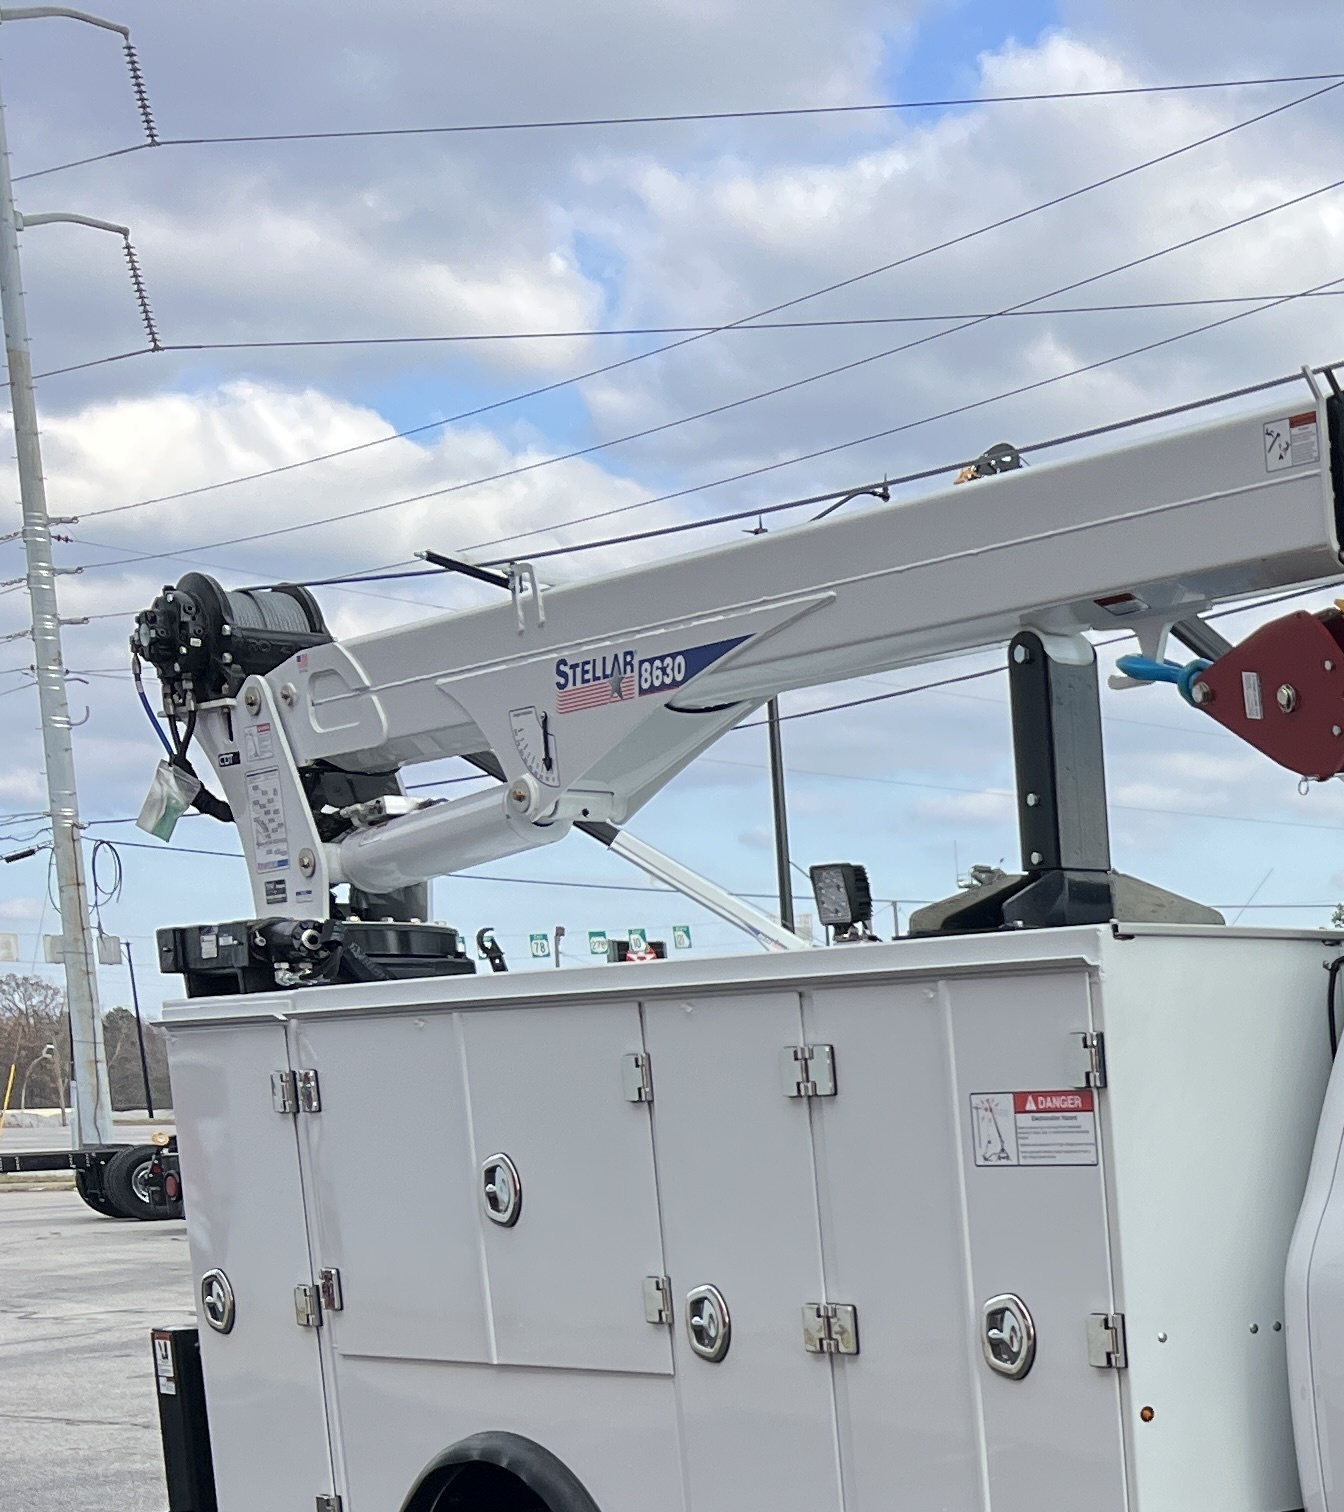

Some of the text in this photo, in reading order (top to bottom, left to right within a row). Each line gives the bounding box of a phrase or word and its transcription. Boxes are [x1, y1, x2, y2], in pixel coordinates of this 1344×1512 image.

[556, 650, 686, 690] STELLAR 8630
[534, 942, 546, 953] 78
[1037, 1096, 1082, 1109] DANGER
